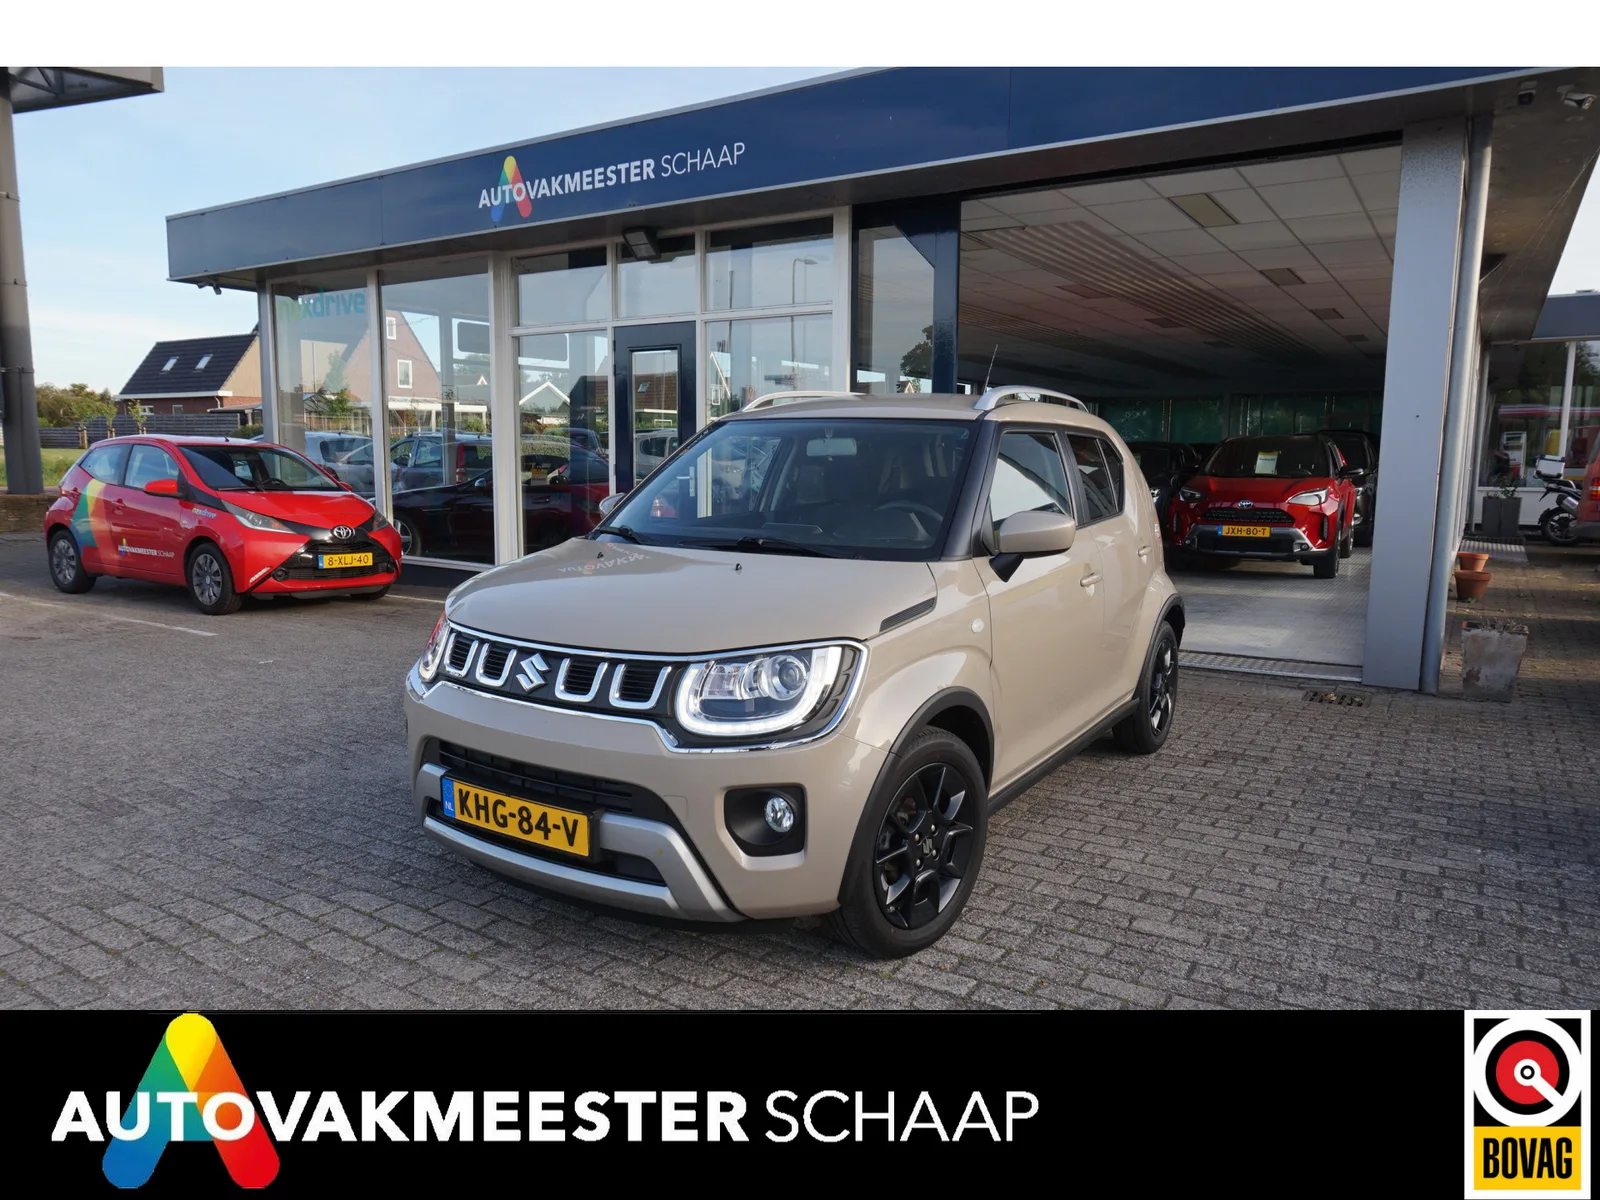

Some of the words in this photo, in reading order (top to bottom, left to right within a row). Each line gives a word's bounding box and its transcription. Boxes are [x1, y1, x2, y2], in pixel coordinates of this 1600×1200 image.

[478, 158, 655, 209] AUTOVAKMEESTER
[660, 142, 746, 177] SCHAAP
[1225, 526, 1267, 536] JXH-80-T
[327, 554, 369, 567] 8-XLJ-40
[458, 788, 579, 847] KHG-84-V
